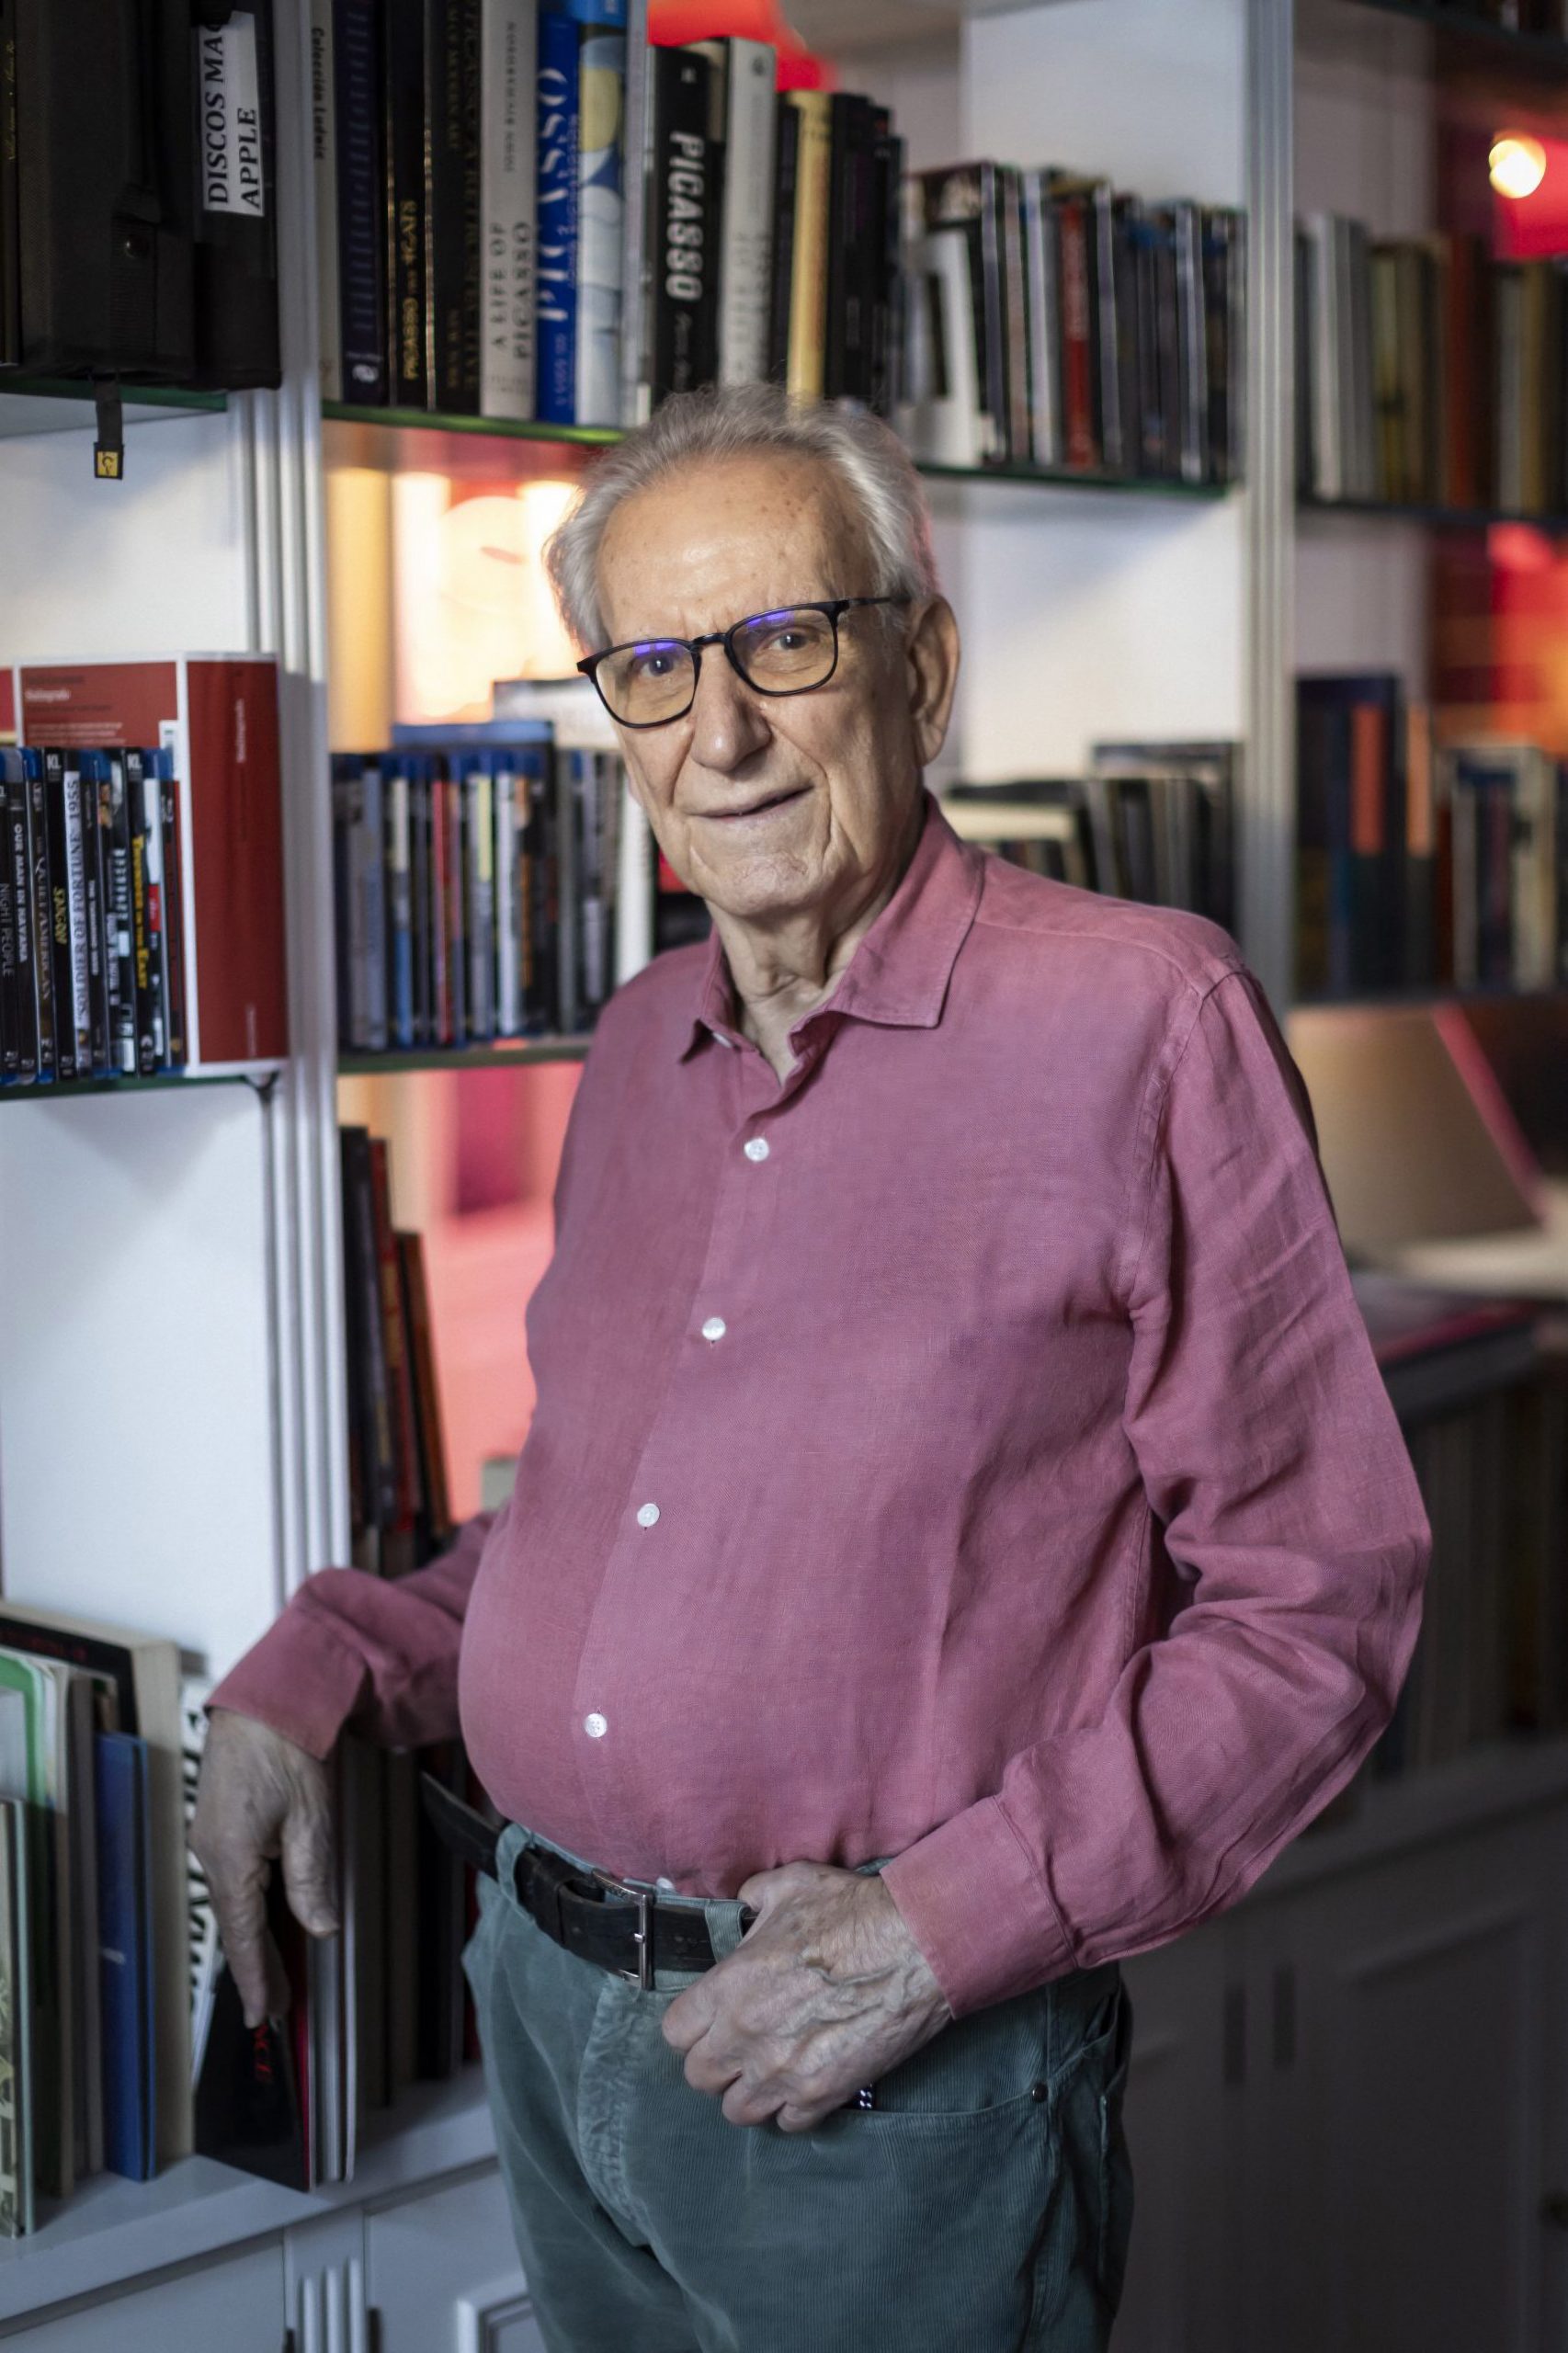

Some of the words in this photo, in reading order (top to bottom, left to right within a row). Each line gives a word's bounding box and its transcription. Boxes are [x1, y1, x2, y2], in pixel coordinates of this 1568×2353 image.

[204, 93, 228, 204] DISCOS
[237, 108, 260, 210] APPLE
[665, 131, 705, 301] PICASSO
[489, 222, 506, 256] OF
[489, 270, 506, 324] LIFE
[512, 222, 532, 360] PICASSO
[489, 335, 506, 351] A
[66, 779, 80, 821] 1955
[13, 823, 25, 853] OUR
[15, 854, 26, 887] MAN
[17, 888, 27, 905] IN
[17, 906, 28, 963] HAVANA
[73, 919, 85, 939] OF
[2, 926, 16, 978] PEOPLE
[136, 947, 150, 991] EAST
